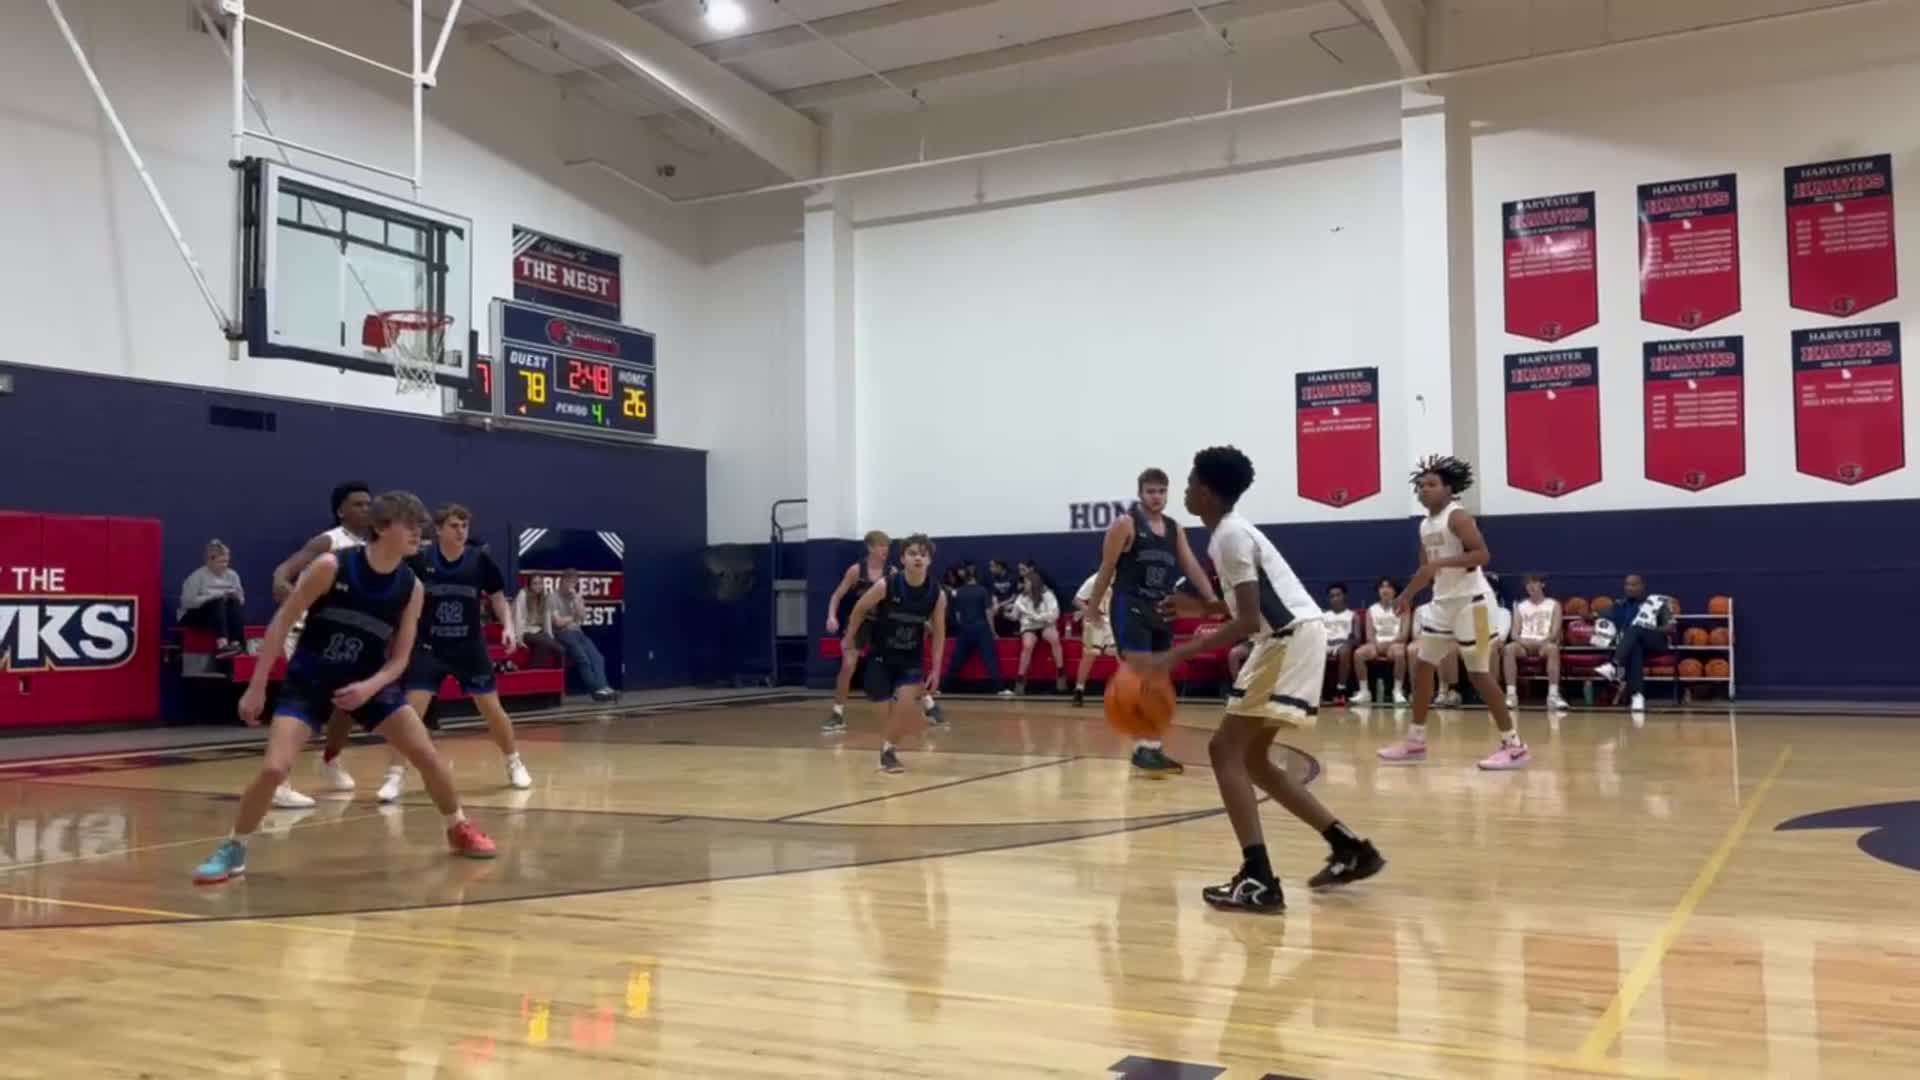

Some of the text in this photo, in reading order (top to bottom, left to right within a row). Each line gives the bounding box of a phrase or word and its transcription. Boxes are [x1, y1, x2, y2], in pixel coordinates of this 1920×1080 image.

[1801, 161, 1873, 177] HARVESTER
[1652, 179, 1719, 195] HARVESTER
[520, 256, 609, 296] THE NEST
[1808, 328, 1881, 341] HARVESTER
[1658, 340, 1726, 352] HARVESTER
[510, 351, 548, 368] GUEST
[1518, 352, 1581, 364] HARVESTER
[569, 360, 609, 394] 2:48
[618, 371, 648, 387] HOME
[1308, 370, 1363, 382] HARVESTER
[518, 370, 545, 402] 78
[555, 402, 588, 416] PERIOD
[623, 387, 647, 418] 26
[592, 404, 602, 424] 4
[1070, 500, 1143, 529] HOM
[12, 567, 65, 591] THE
[583, 606, 616, 626] EST
